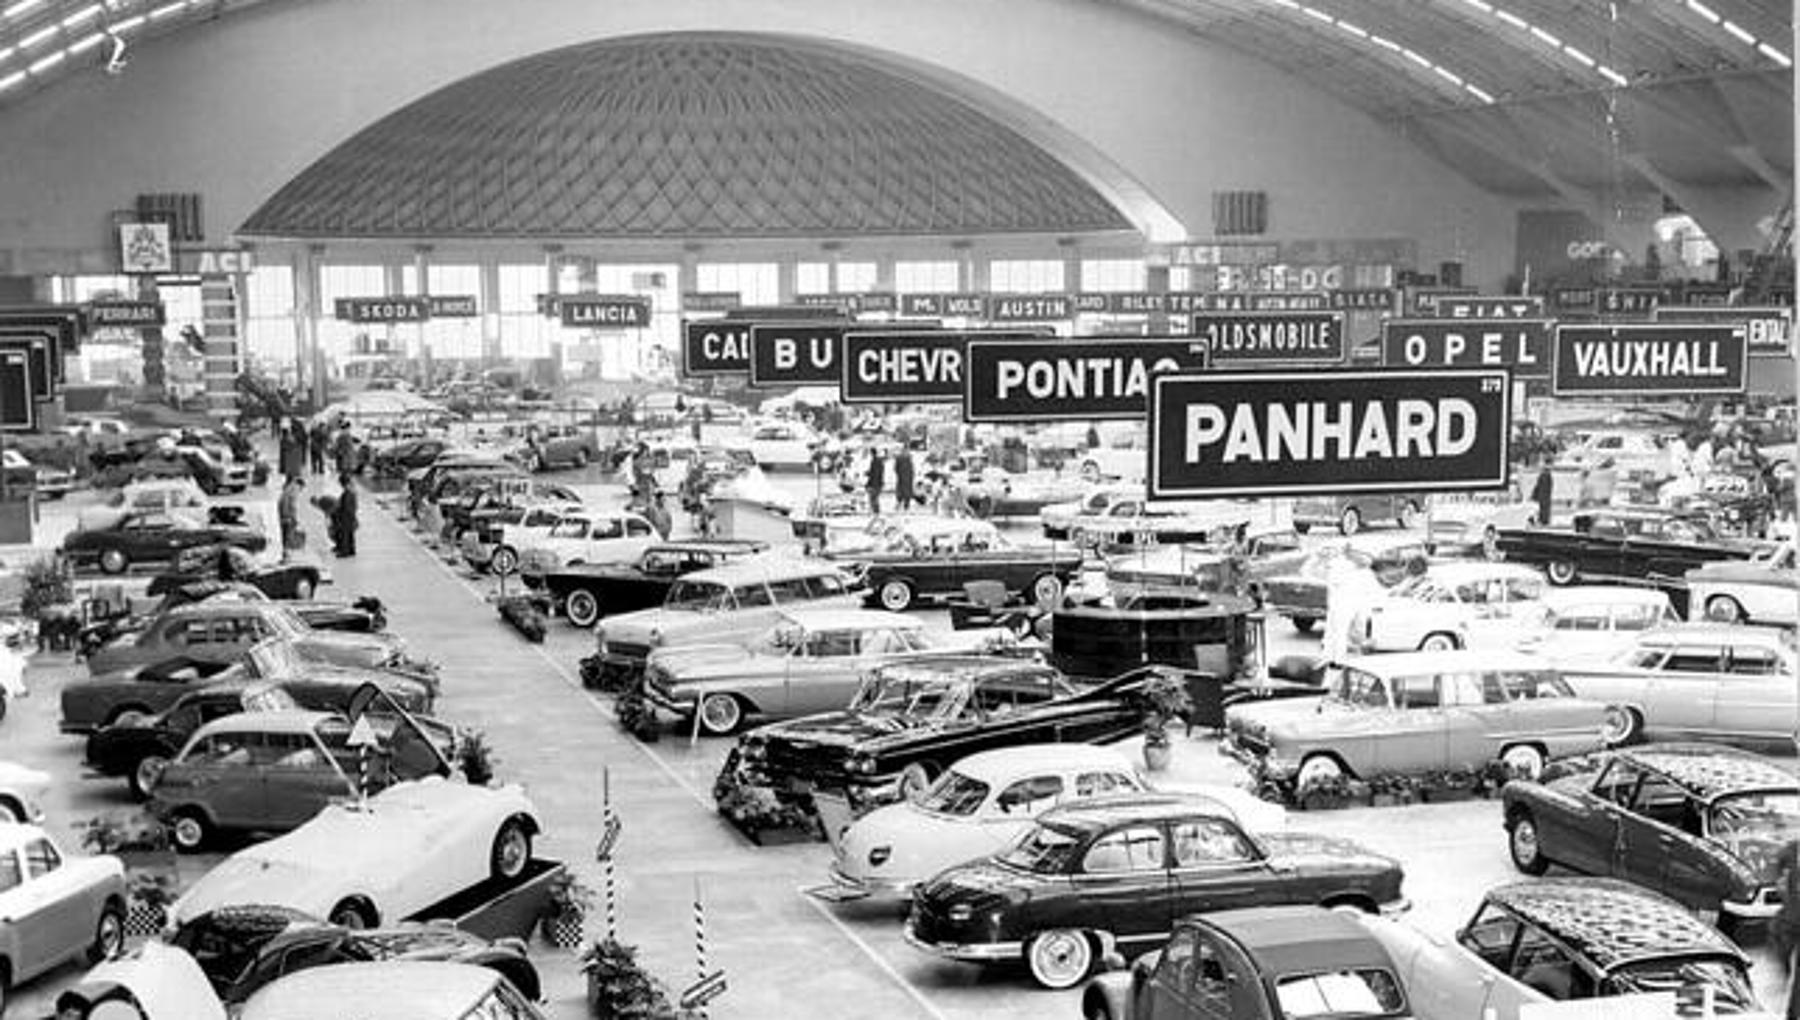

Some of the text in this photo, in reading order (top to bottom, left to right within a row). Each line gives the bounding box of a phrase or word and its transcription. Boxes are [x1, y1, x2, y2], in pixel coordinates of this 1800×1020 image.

[199, 251, 252, 273] ACI
[360, 304, 420, 318] SKODA
[573, 305, 638, 321] LANCIA
[1000, 301, 1067, 317] AUSTIN
[1405, 333, 1536, 365] OPEL
[1573, 341, 1728, 378] VAUXHALL
[996, 357, 1178, 399] PONTIA
[1185, 396, 1478, 464] PANHARD
